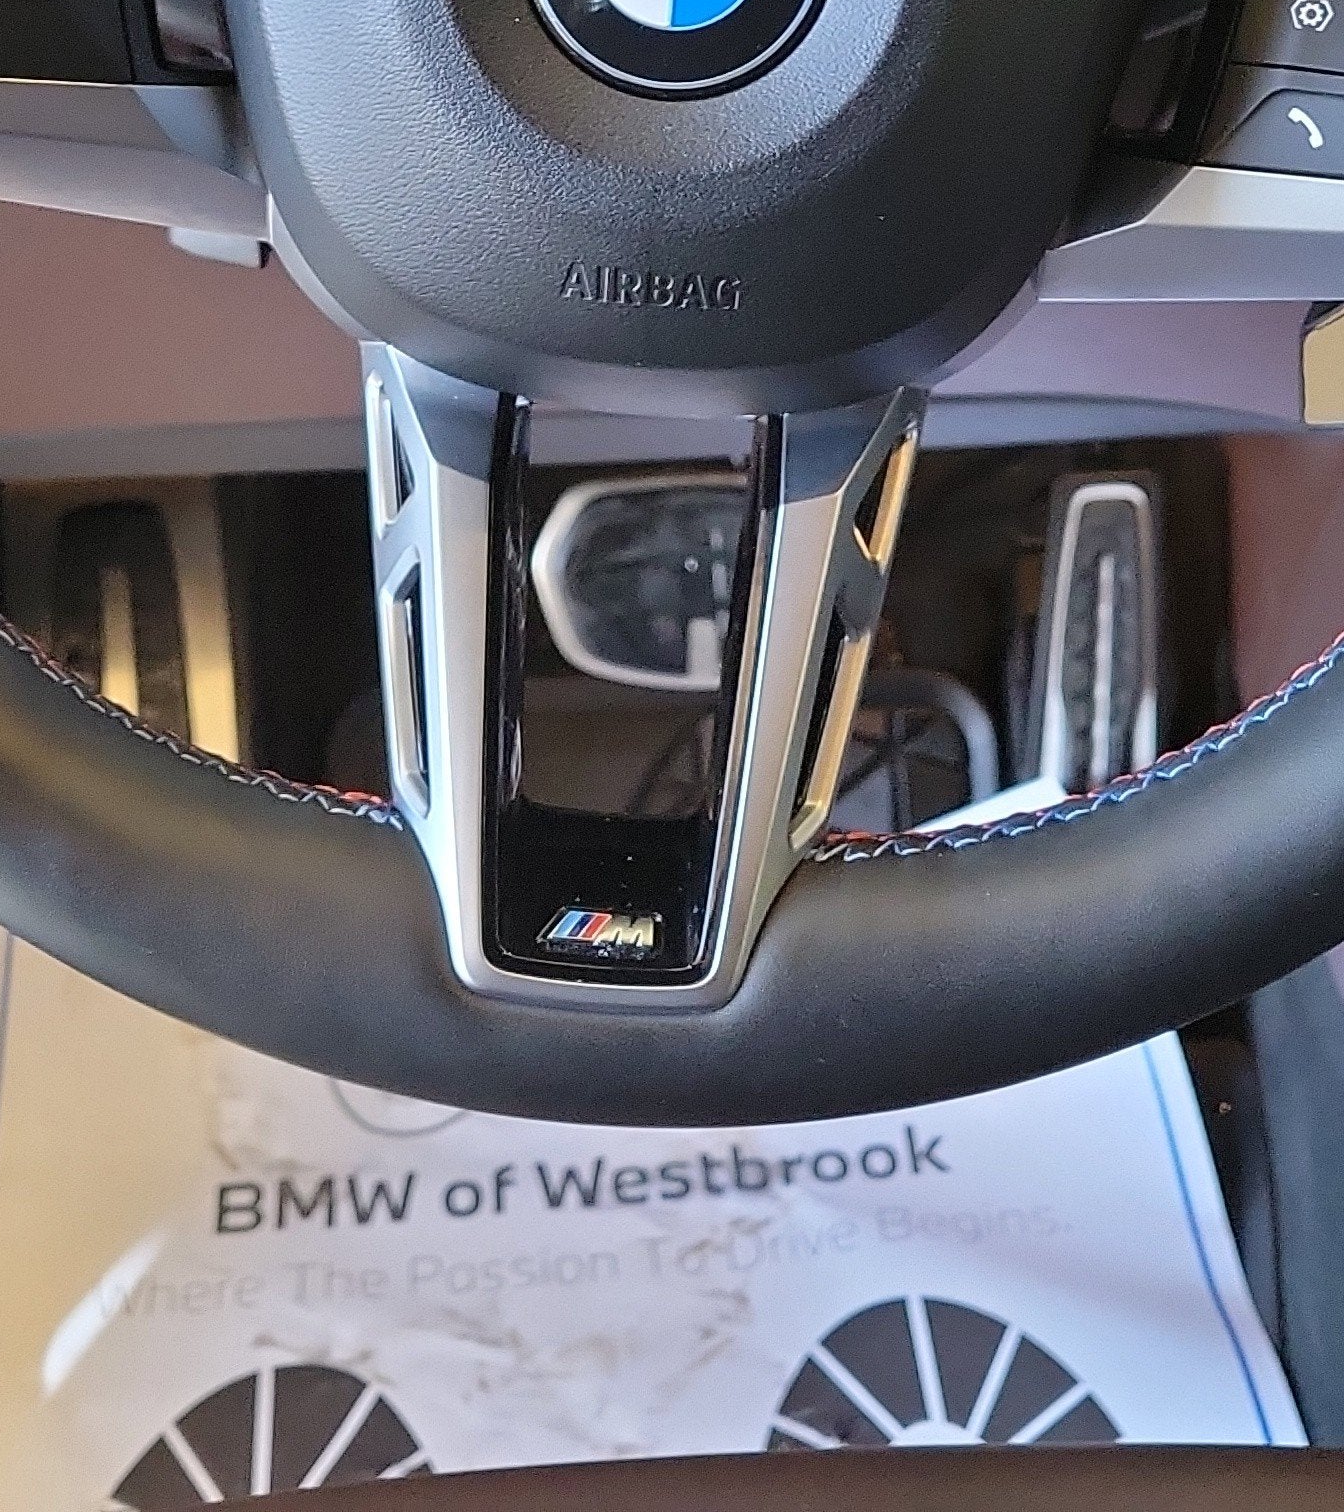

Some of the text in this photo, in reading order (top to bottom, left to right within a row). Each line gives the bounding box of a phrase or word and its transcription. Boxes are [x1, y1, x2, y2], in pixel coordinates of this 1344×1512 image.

[559, 258, 742, 311] AIRBAG
[216, 1124, 952, 1235] BMW of Westbrook
[288, 1258, 386, 1304] The
[406, 1250, 620, 1300] Passion
[639, 1234, 710, 1277] To
[727, 1221, 858, 1272] Drive
